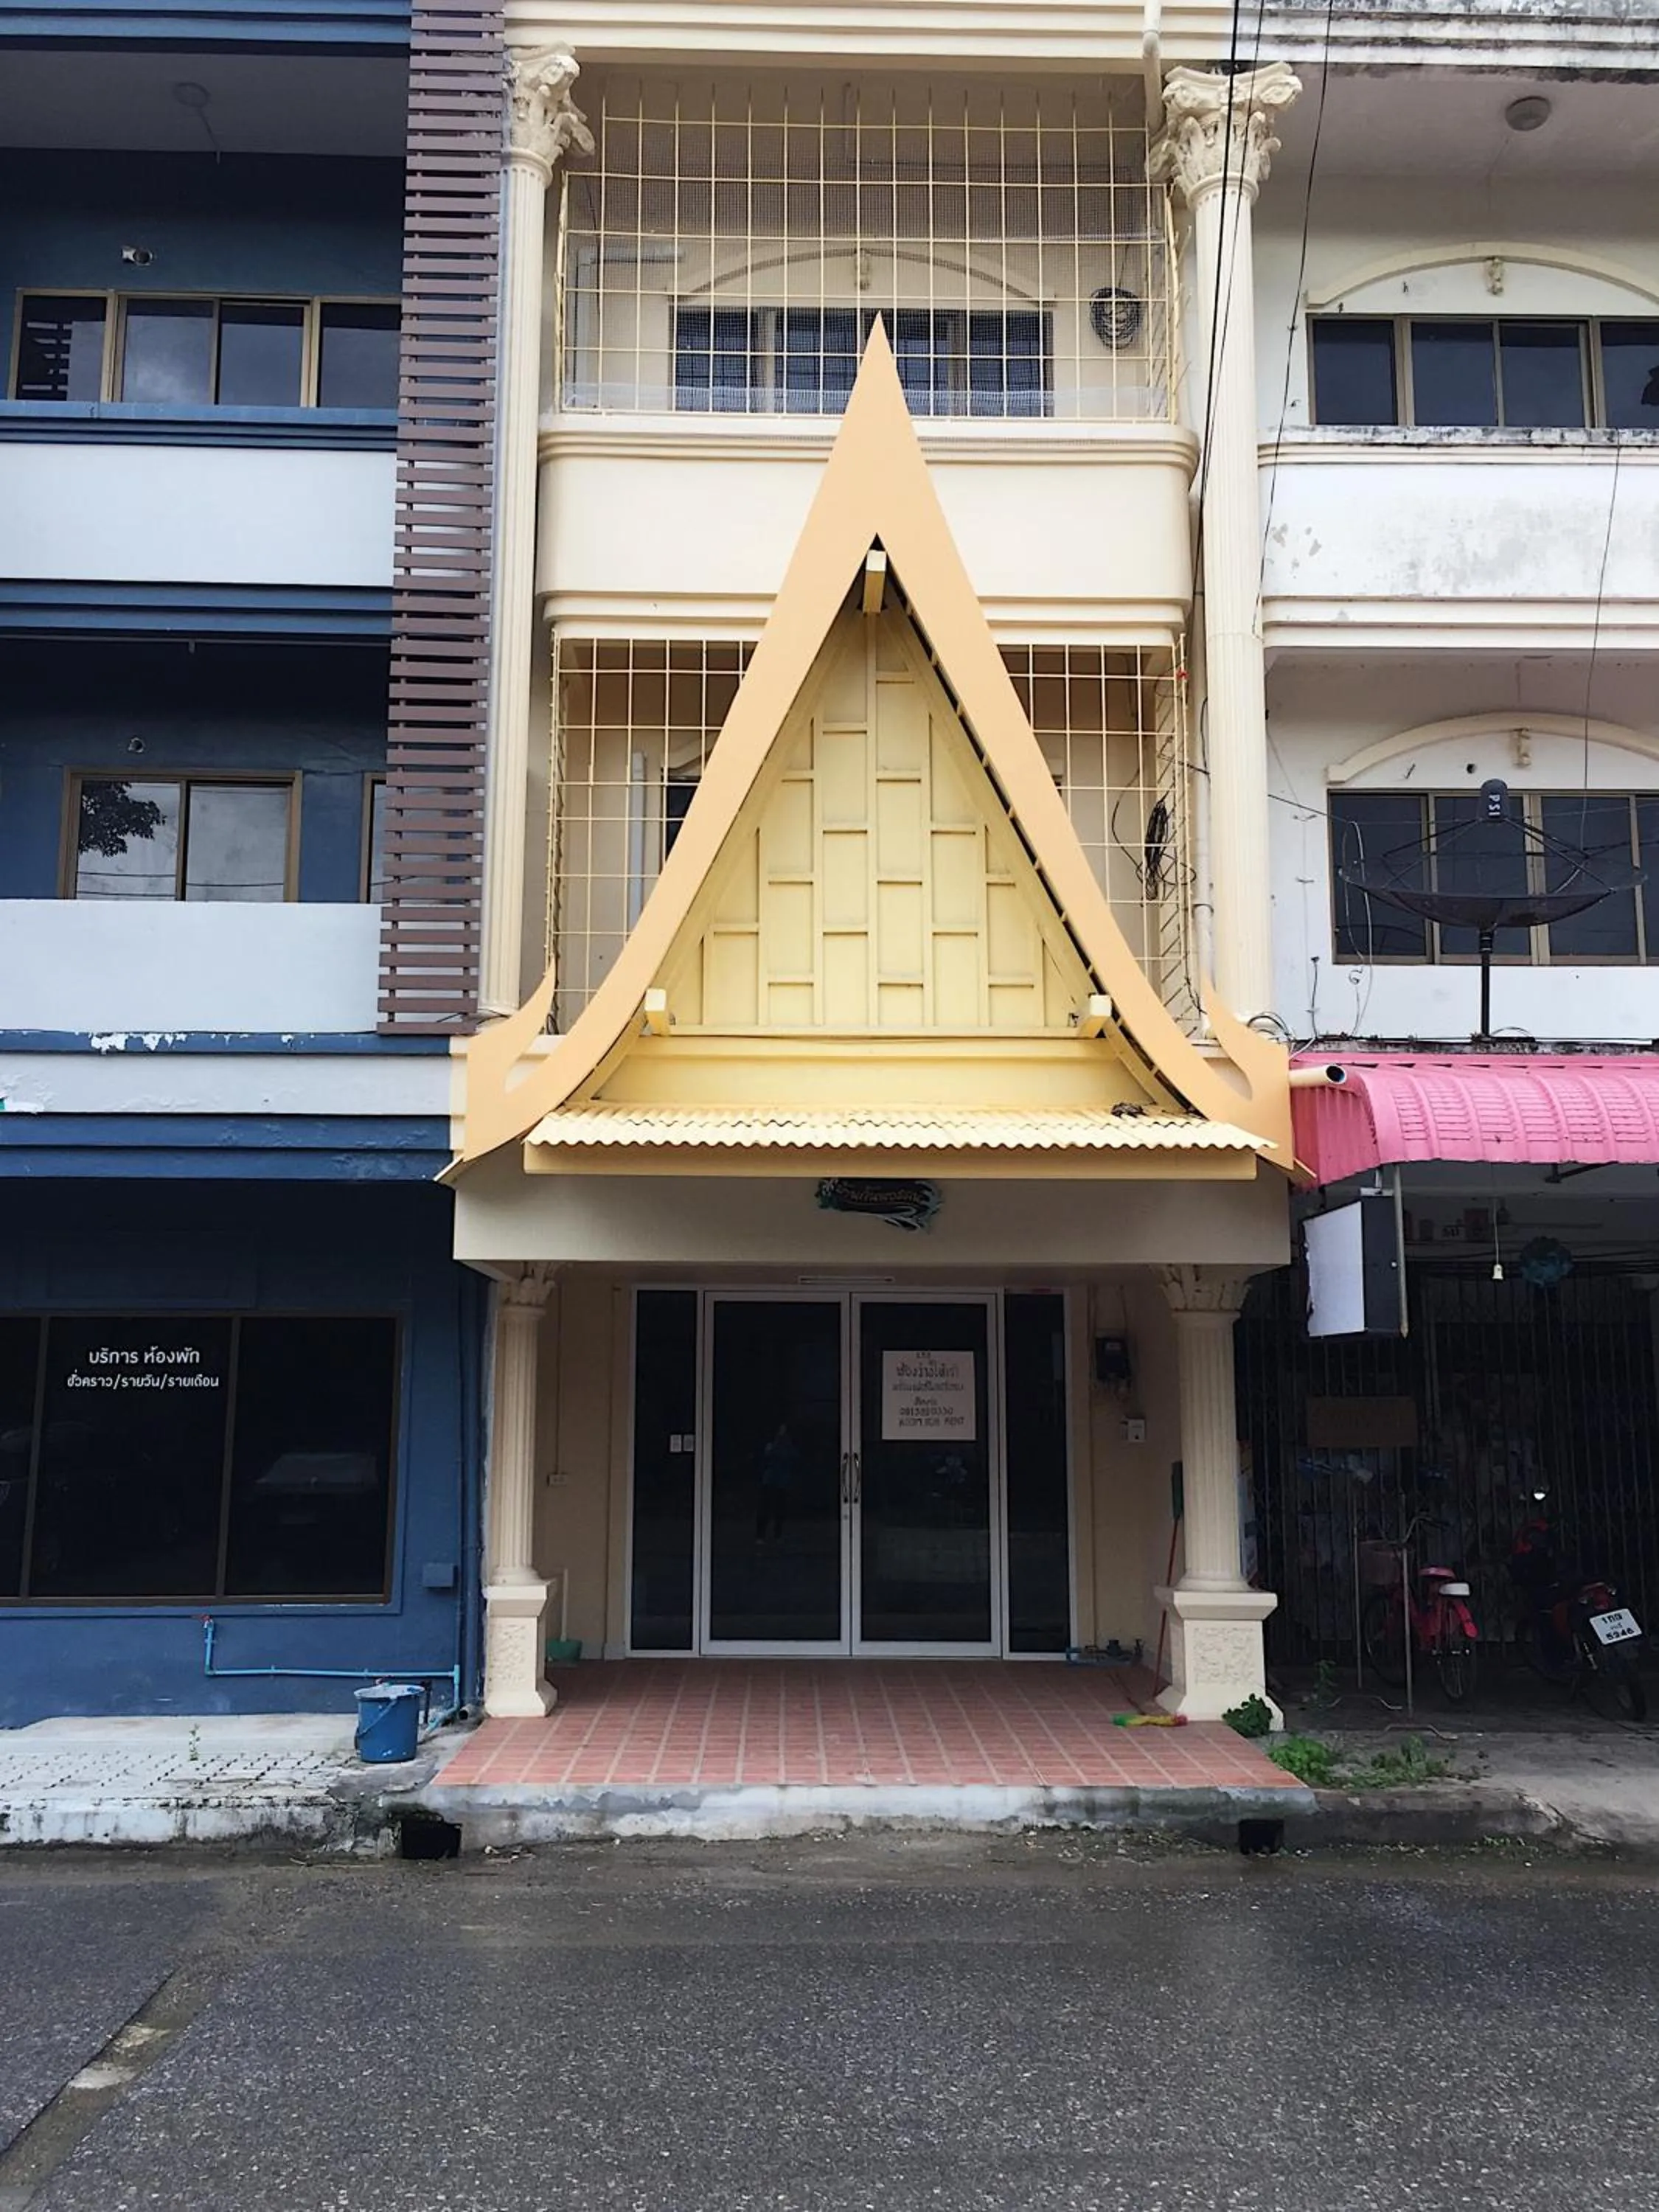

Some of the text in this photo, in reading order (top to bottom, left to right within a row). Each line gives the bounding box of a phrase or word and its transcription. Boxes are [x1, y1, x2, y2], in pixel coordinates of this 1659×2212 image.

[1488, 794, 1501, 816] PSI
[88, 1345, 201, 1364] บริการ ห้องพัก
[67, 1368, 220, 1391] ชั่วคราว/รายวัน/รายเดือน
